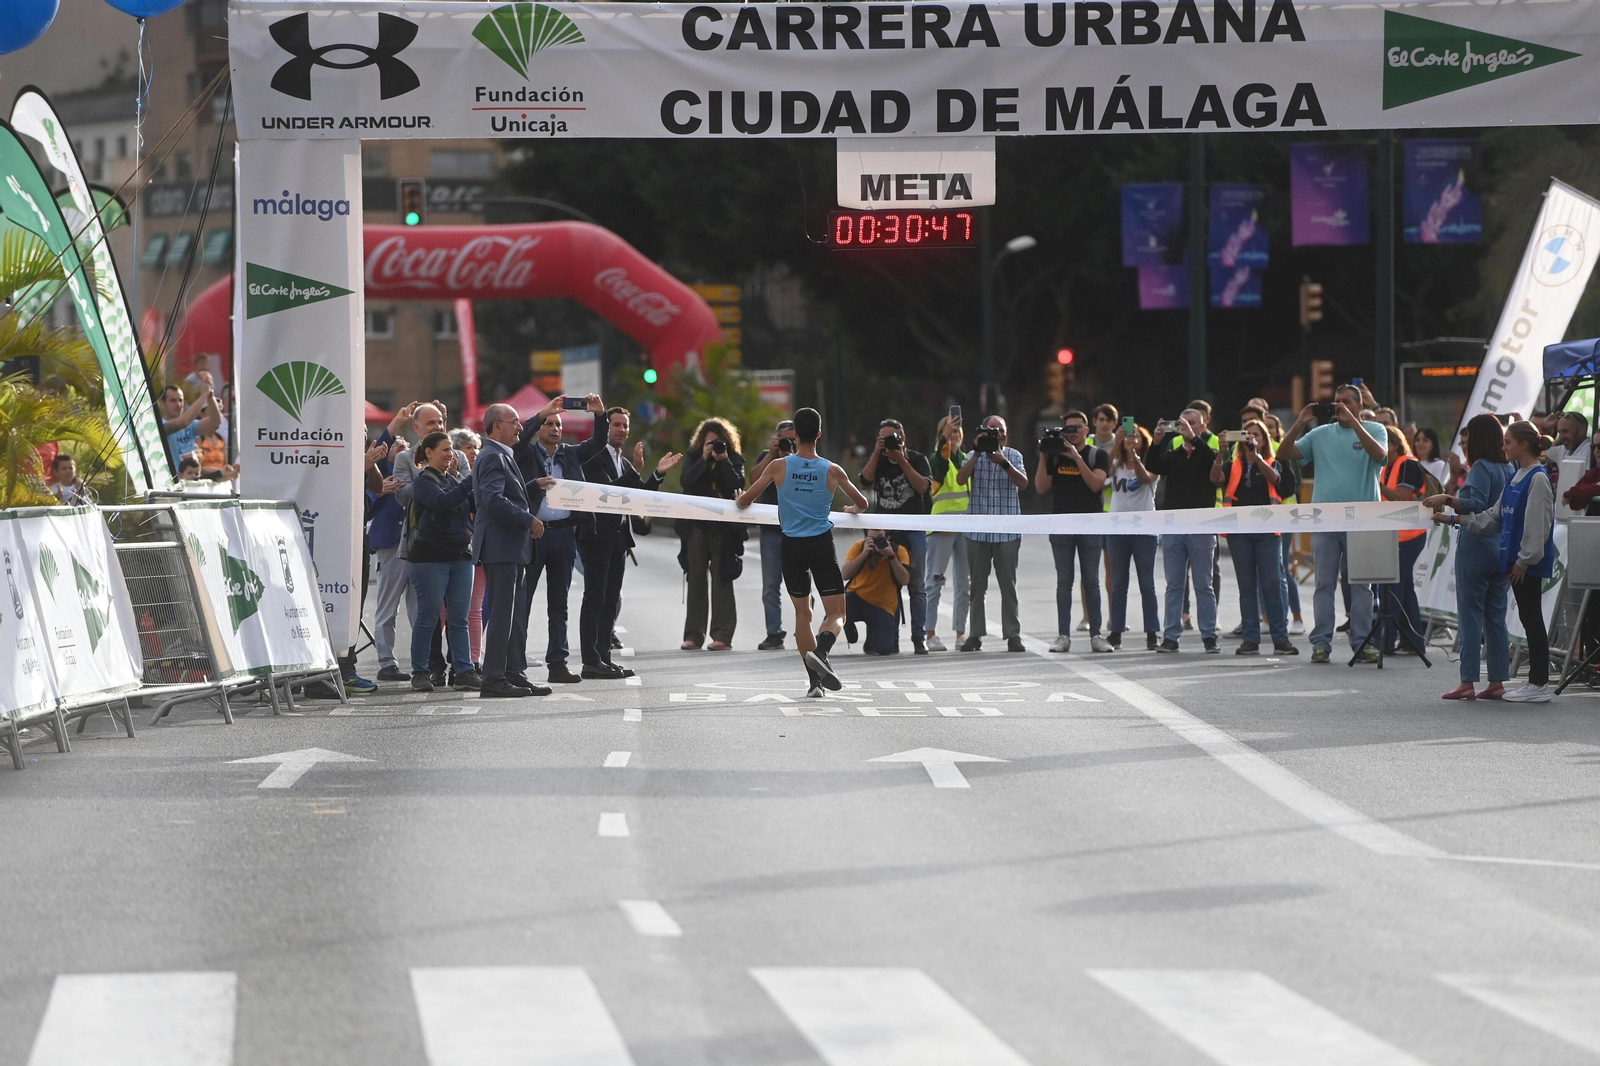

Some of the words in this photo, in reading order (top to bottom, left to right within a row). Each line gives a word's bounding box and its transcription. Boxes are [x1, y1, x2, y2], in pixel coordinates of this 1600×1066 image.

[681, 3, 1001, 51] CARRERA
[1024, 0, 1306, 47] URBANA
[1388, 46, 1409, 68] El
[1410, 47, 1460, 68] Corte
[1461, 41, 1534, 74] Inglés
[475, 86, 584, 102] Fundación
[660, 89, 911, 135] CIUDAD
[936, 87, 1020, 133] DE
[1045, 75, 1328, 132] MÁLAGA
[262, 117, 335, 130] UNDER
[339, 116, 431, 129] ARMOUR
[491, 113, 569, 137] Unicaja
[860, 173, 972, 201] META
[253, 189, 350, 221] málaga
[836, 213, 972, 244] 00:30:47
[1548, 228, 1582, 252] BMW
[365, 234, 543, 291] Coca-Cola
[248, 283, 261, 296] El
[261, 283, 289, 296] Corte
[289, 281, 331, 300] Inglés
[257, 427, 344, 442] Fundación
[270, 449, 330, 468] Unicaja
[791, 472, 818, 482] nerja
[778, 706, 1005, 717] RED
